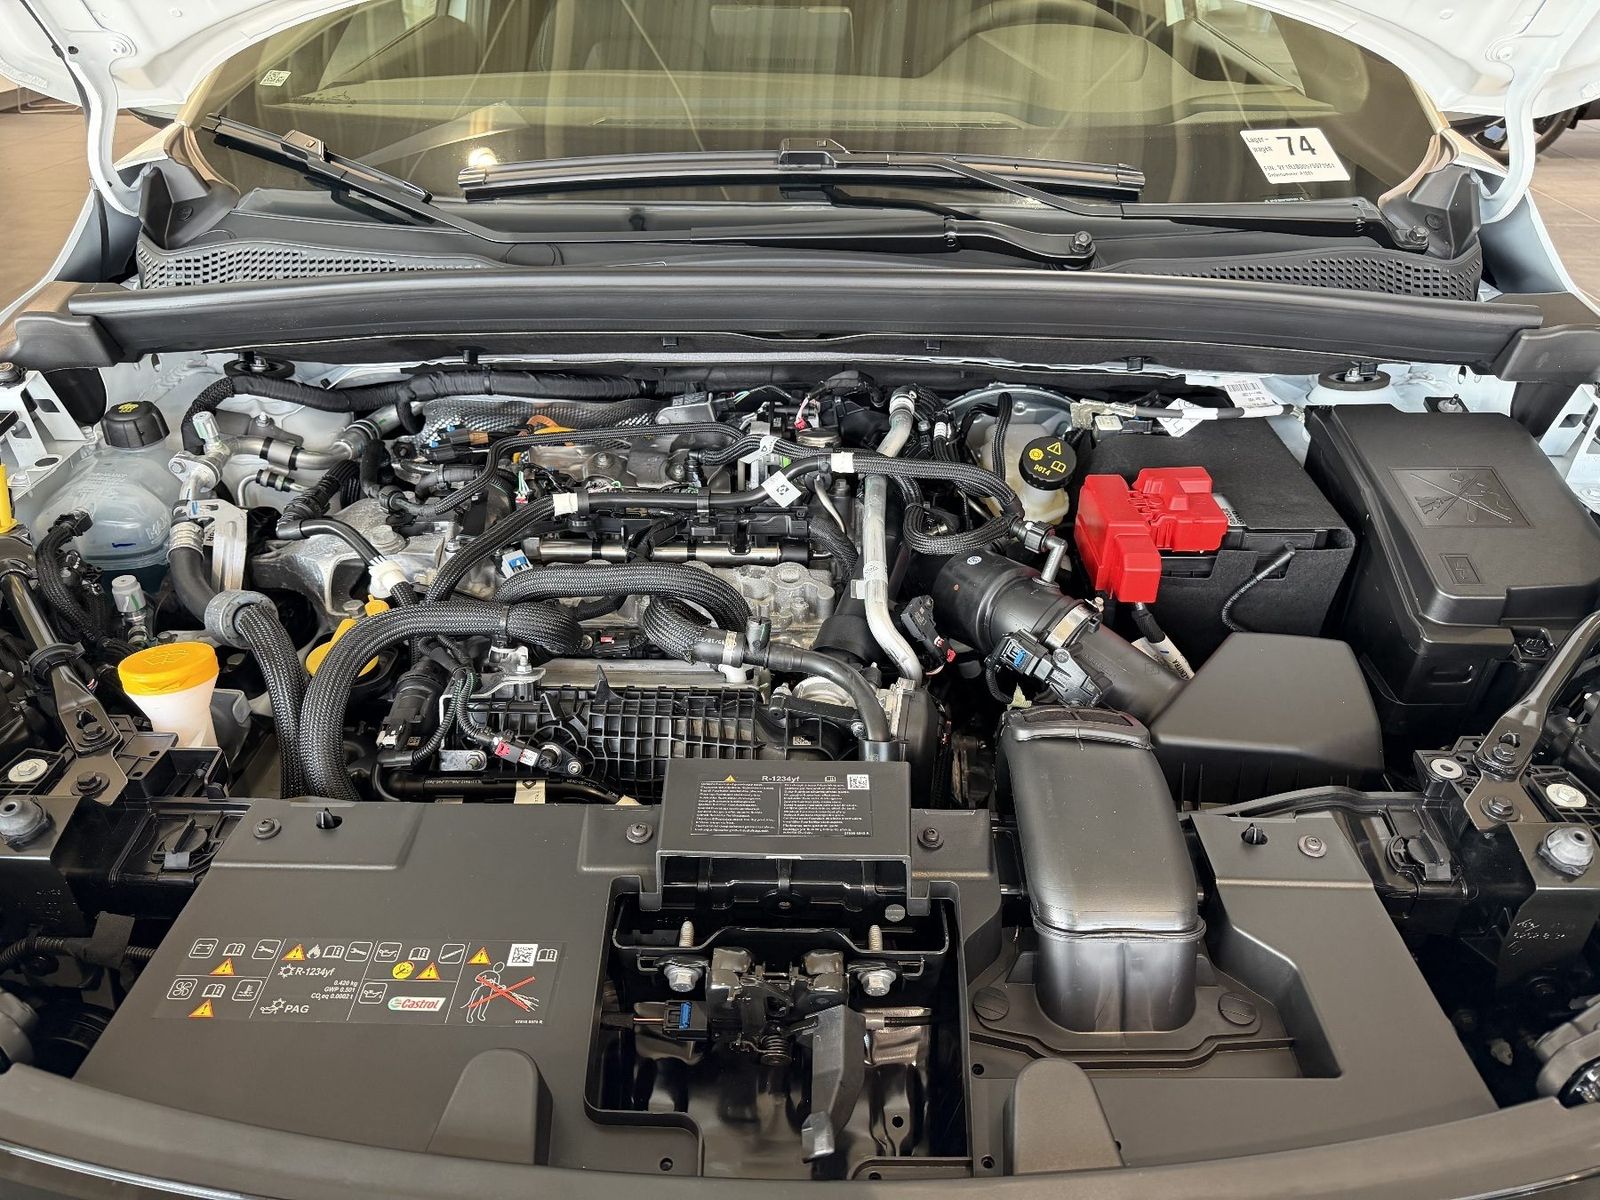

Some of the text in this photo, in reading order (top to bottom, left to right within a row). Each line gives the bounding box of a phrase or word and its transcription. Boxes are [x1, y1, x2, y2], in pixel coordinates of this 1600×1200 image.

[1275, 135, 1317, 156] 74
[761, 775, 800, 783] R-1234yf
[294, 967, 335, 978] R-1234yf
[284, 1004, 310, 1013] PAG
[401, 998, 440, 1009] Castrol
